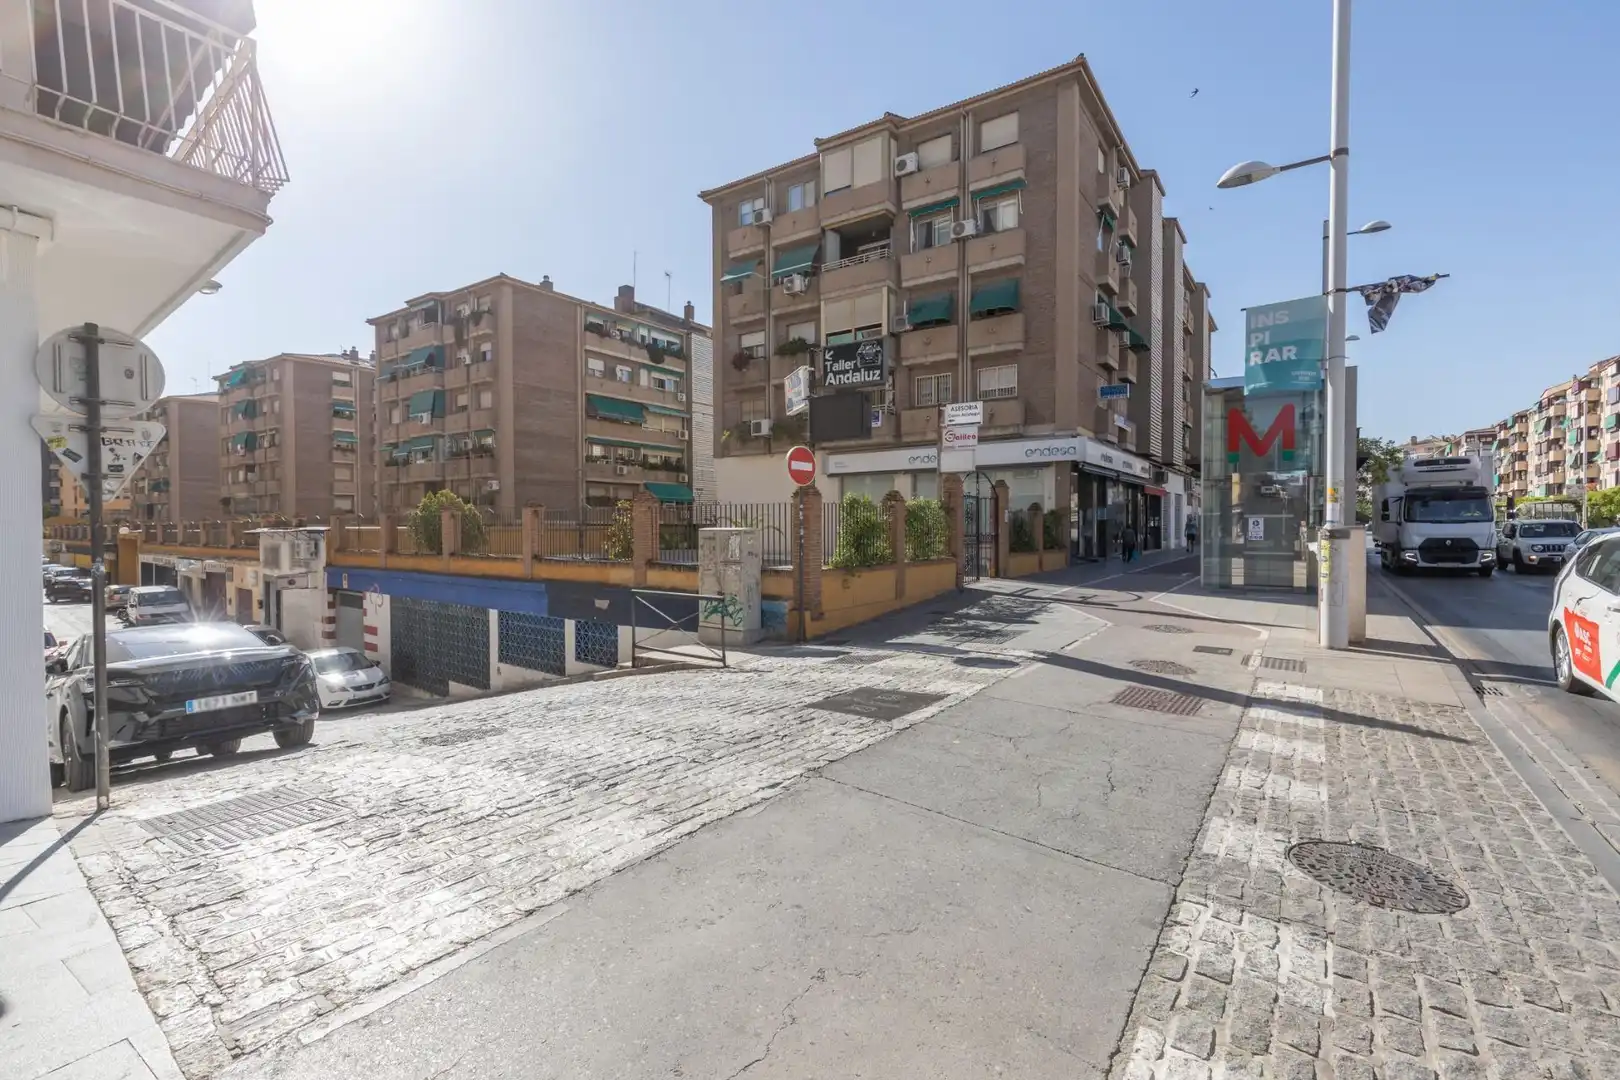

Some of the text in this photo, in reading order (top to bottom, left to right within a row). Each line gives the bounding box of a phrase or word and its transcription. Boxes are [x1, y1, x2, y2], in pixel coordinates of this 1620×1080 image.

[1250, 310, 1289, 329] INS
[1249, 330, 1270, 348] PI
[1249, 345, 1298, 366] RAR
[825, 360, 857, 372] Taller
[825, 368, 881, 386] Andaluz
[1228, 403, 1296, 464] M
[908, 453, 938, 465] ende
[1025, 445, 1077, 458] endesa
